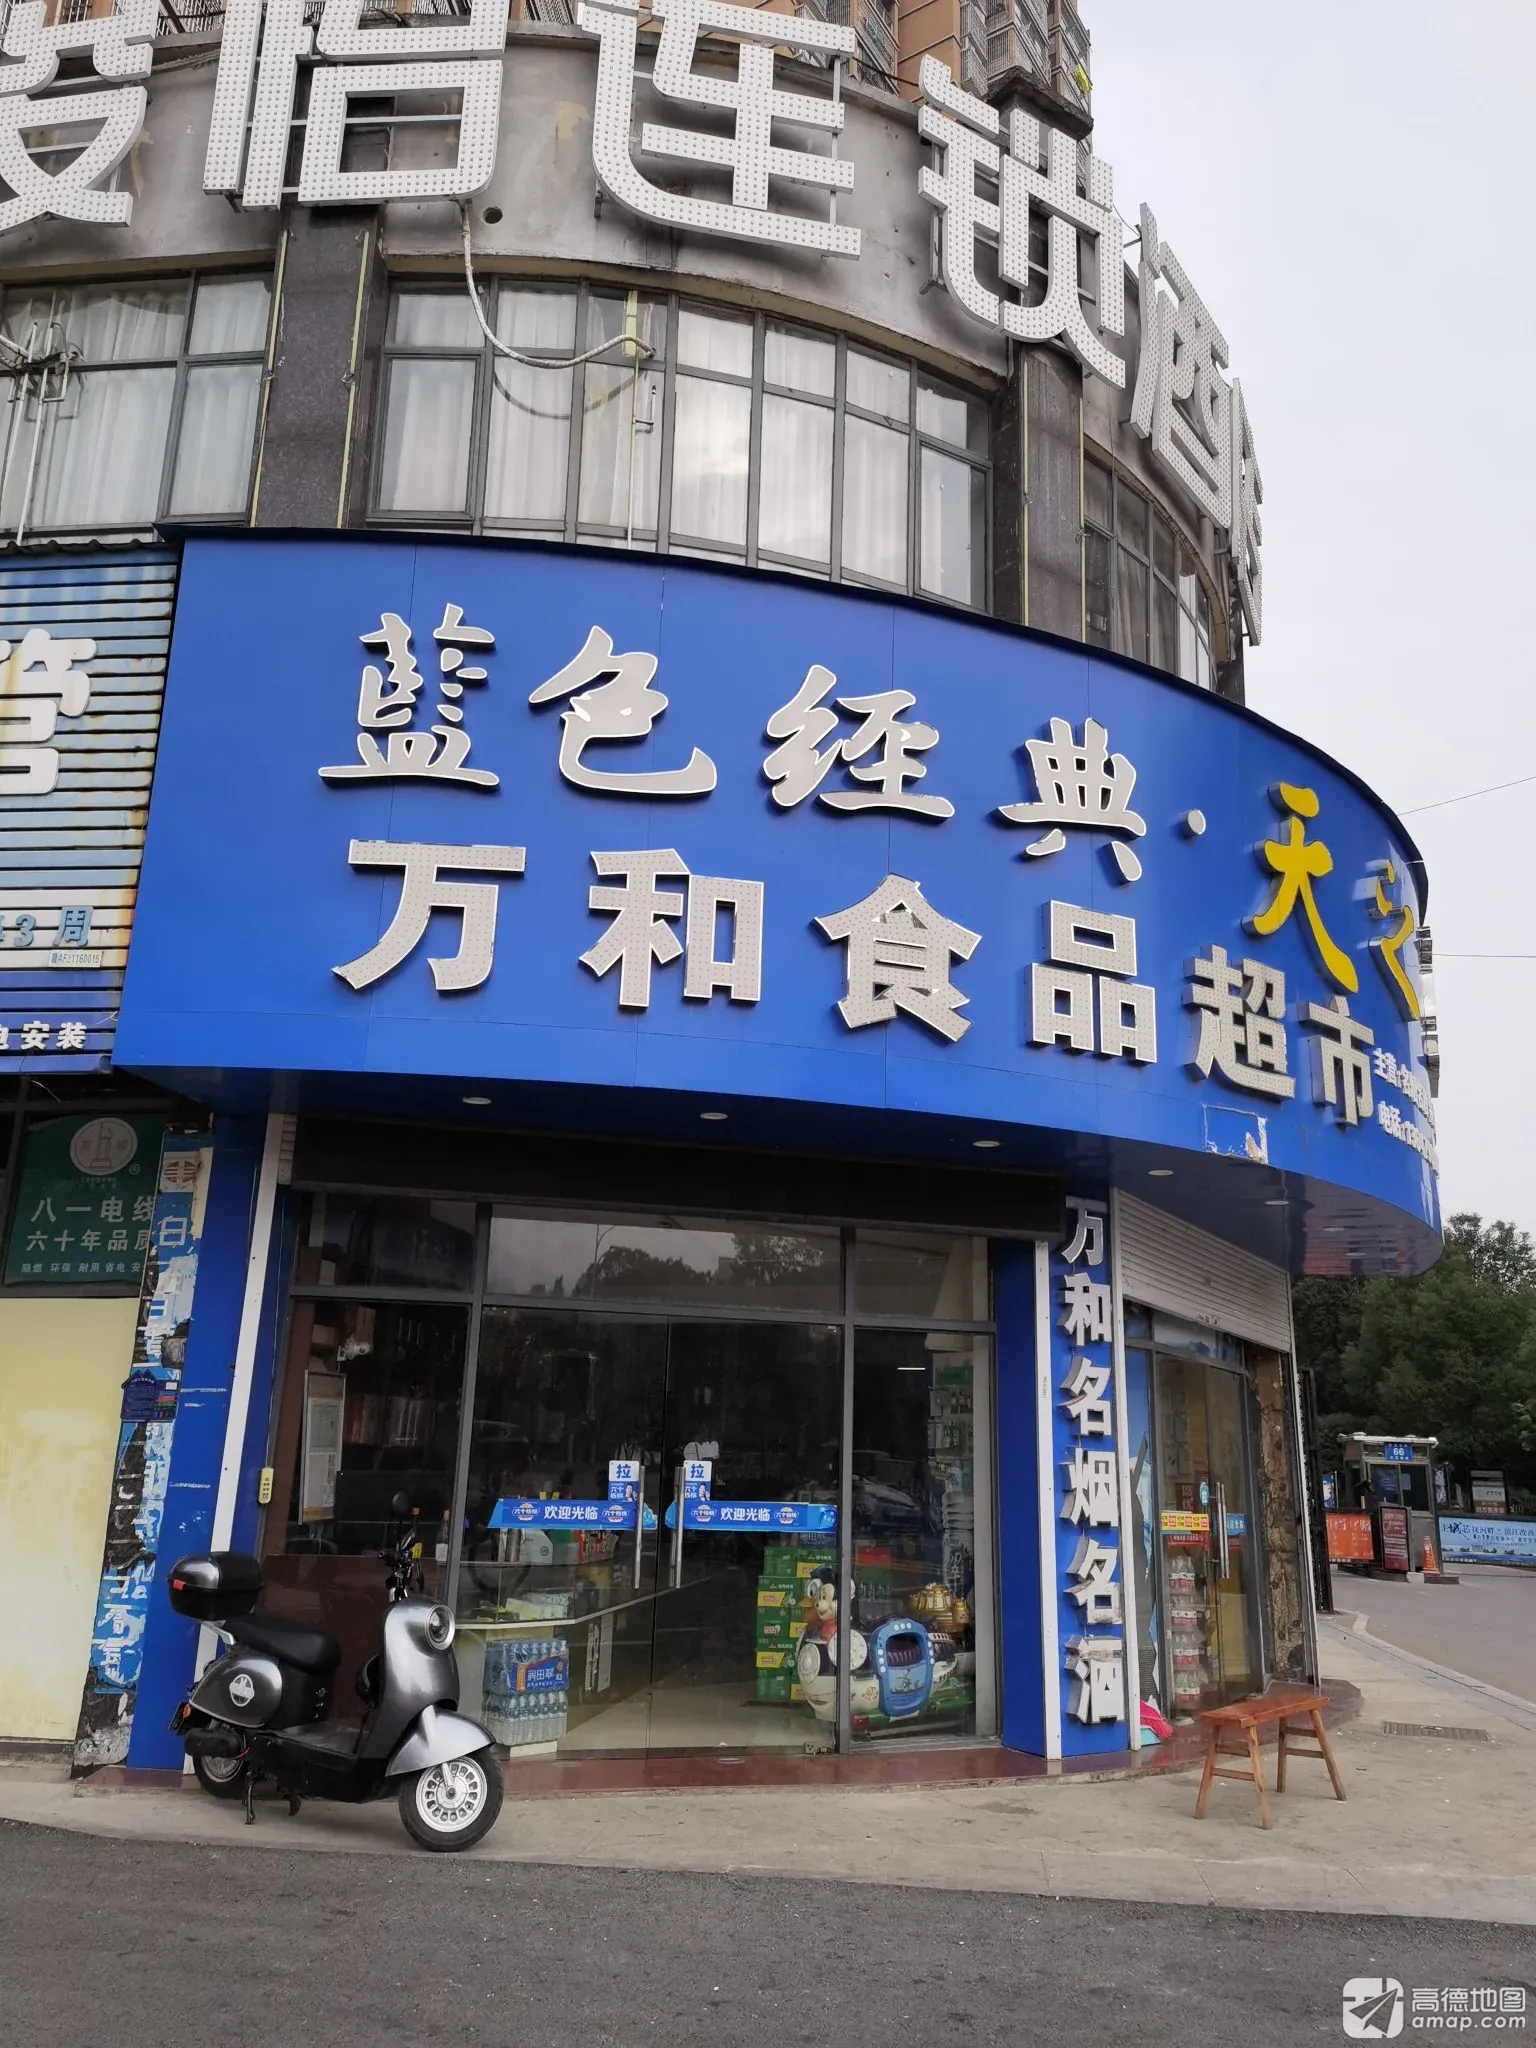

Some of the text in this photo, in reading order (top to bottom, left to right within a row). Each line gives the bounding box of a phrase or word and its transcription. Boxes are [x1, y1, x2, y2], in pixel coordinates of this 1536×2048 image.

[330, 838, 1375, 1127] 万和食品超市
[50, 1262, 72, 1273] 环保
[78, 1262, 100, 1273] 耐用
[105, 1262, 126, 1273] 省电
[131, 1262, 145, 1273] 安
[1060, 1199, 1125, 1724] 万和名烟名酒
[616, 1463, 632, 1479] 拉
[690, 1463, 705, 1479] 拉
[544, 1505, 598, 1520] 欢迎光临
[720, 1507, 770, 1521] 欢迎光临
